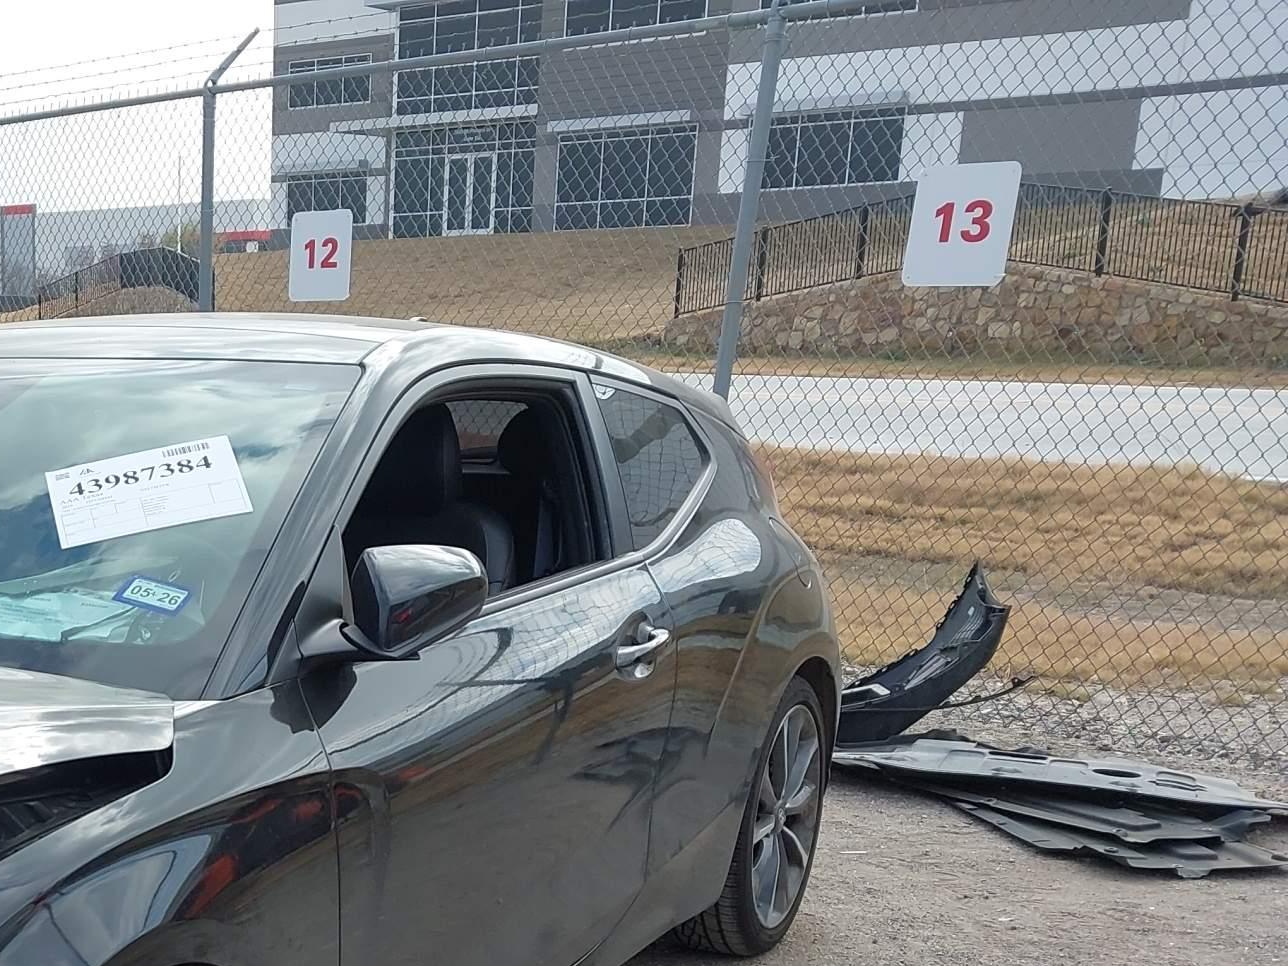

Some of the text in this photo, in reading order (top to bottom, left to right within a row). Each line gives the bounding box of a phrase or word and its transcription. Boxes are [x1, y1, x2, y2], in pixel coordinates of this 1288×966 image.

[934, 199, 994, 243] 13
[304, 237, 339, 269] 12
[68, 455, 213, 496] 43987384
[130, 585, 152, 598] 05
[157, 592, 181, 606] 26
